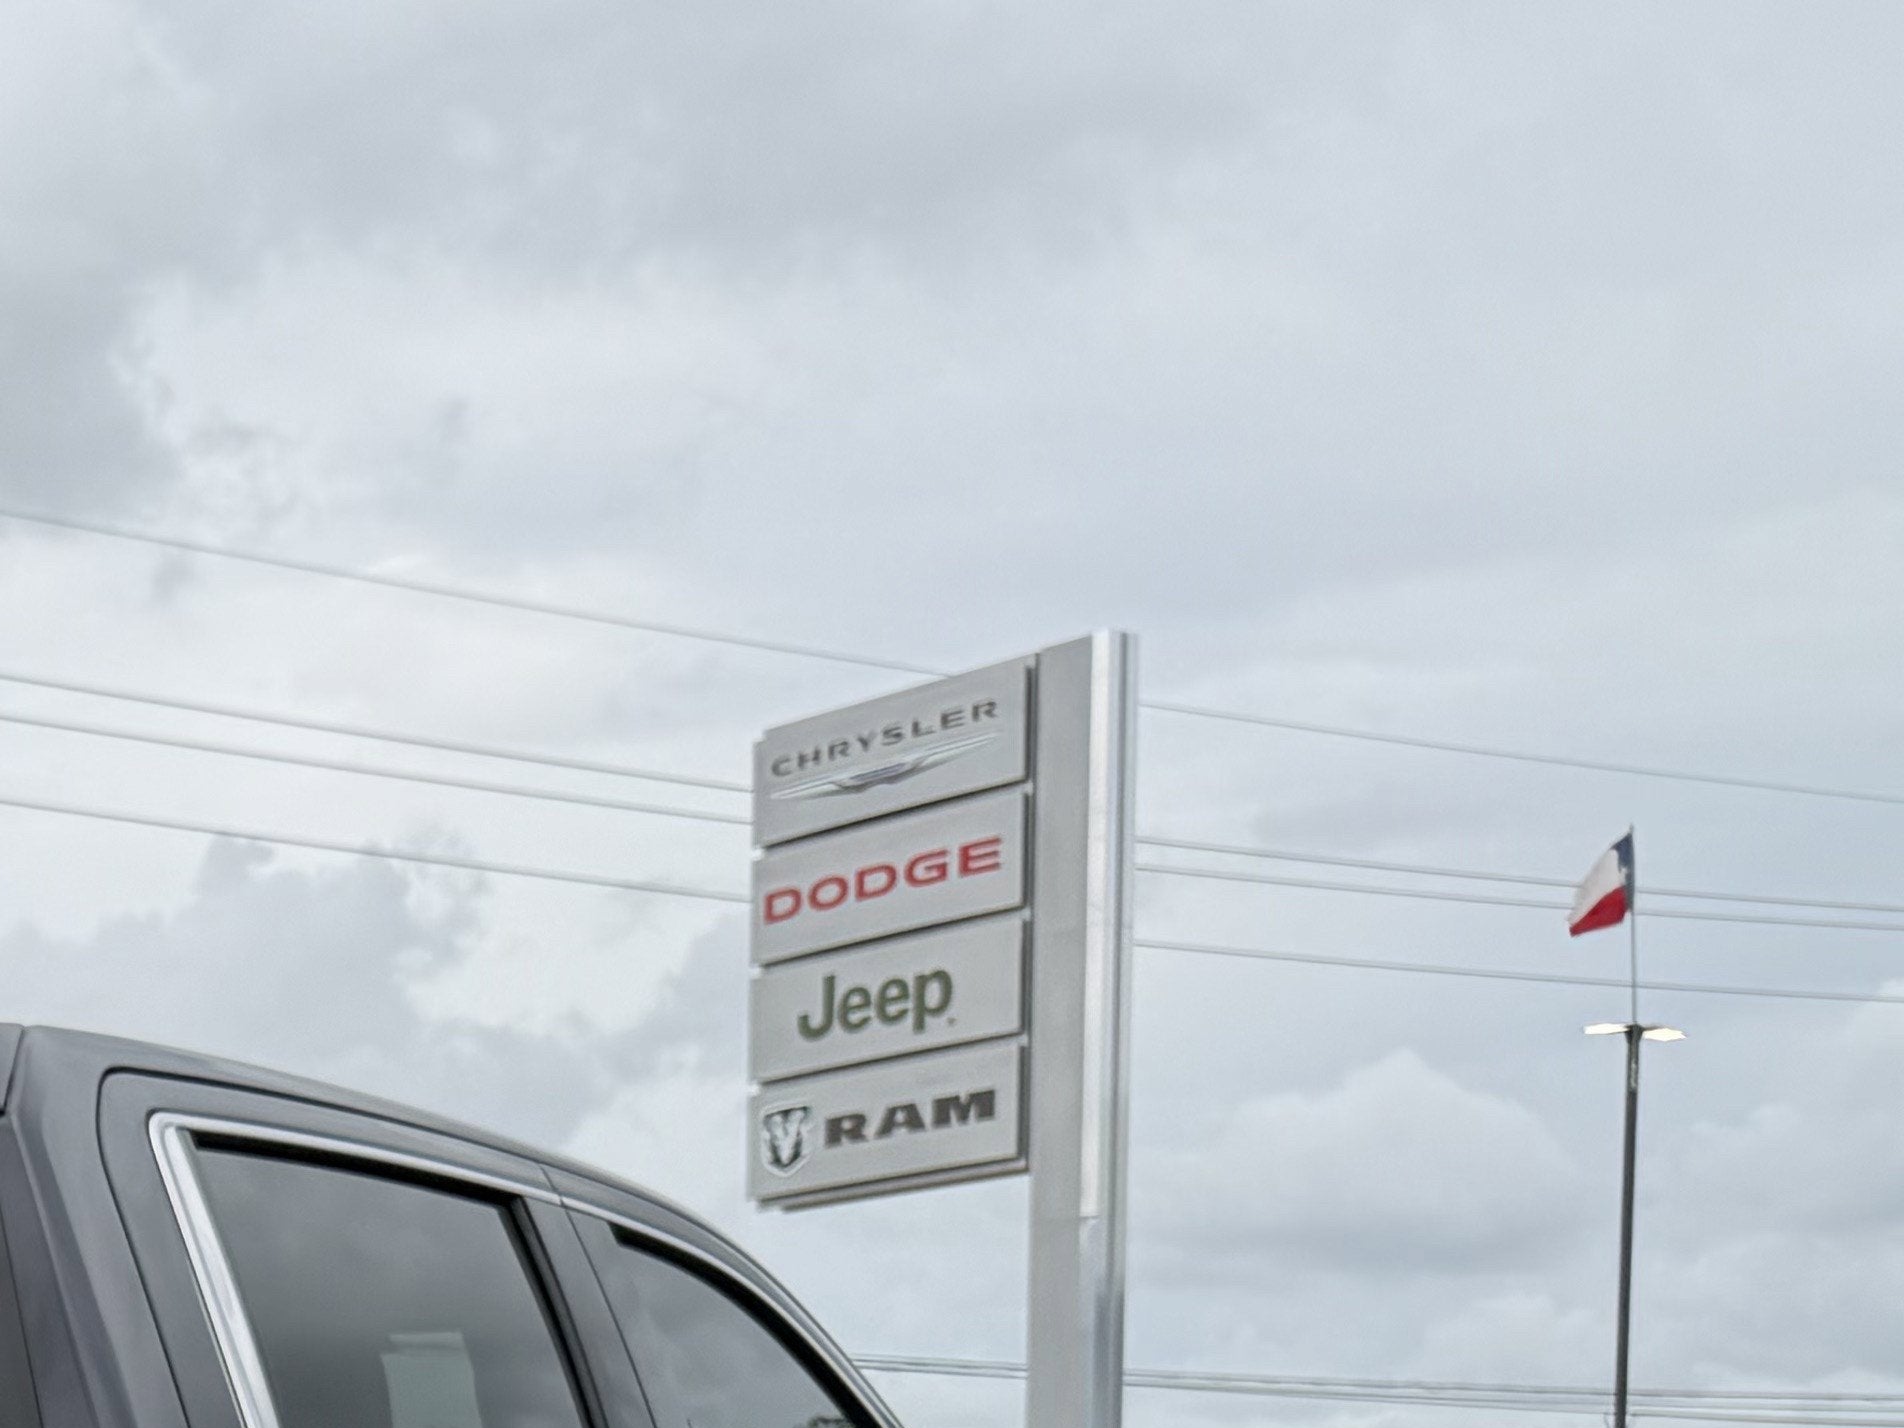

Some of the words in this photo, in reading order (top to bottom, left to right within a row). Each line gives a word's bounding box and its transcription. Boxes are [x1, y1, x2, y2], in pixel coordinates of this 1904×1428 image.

[771, 701, 998, 777] CHRYSLER
[763, 834, 1003, 924] DODGE
[797, 969, 953, 1042] Jeep
[824, 1088, 996, 1149] RAM
